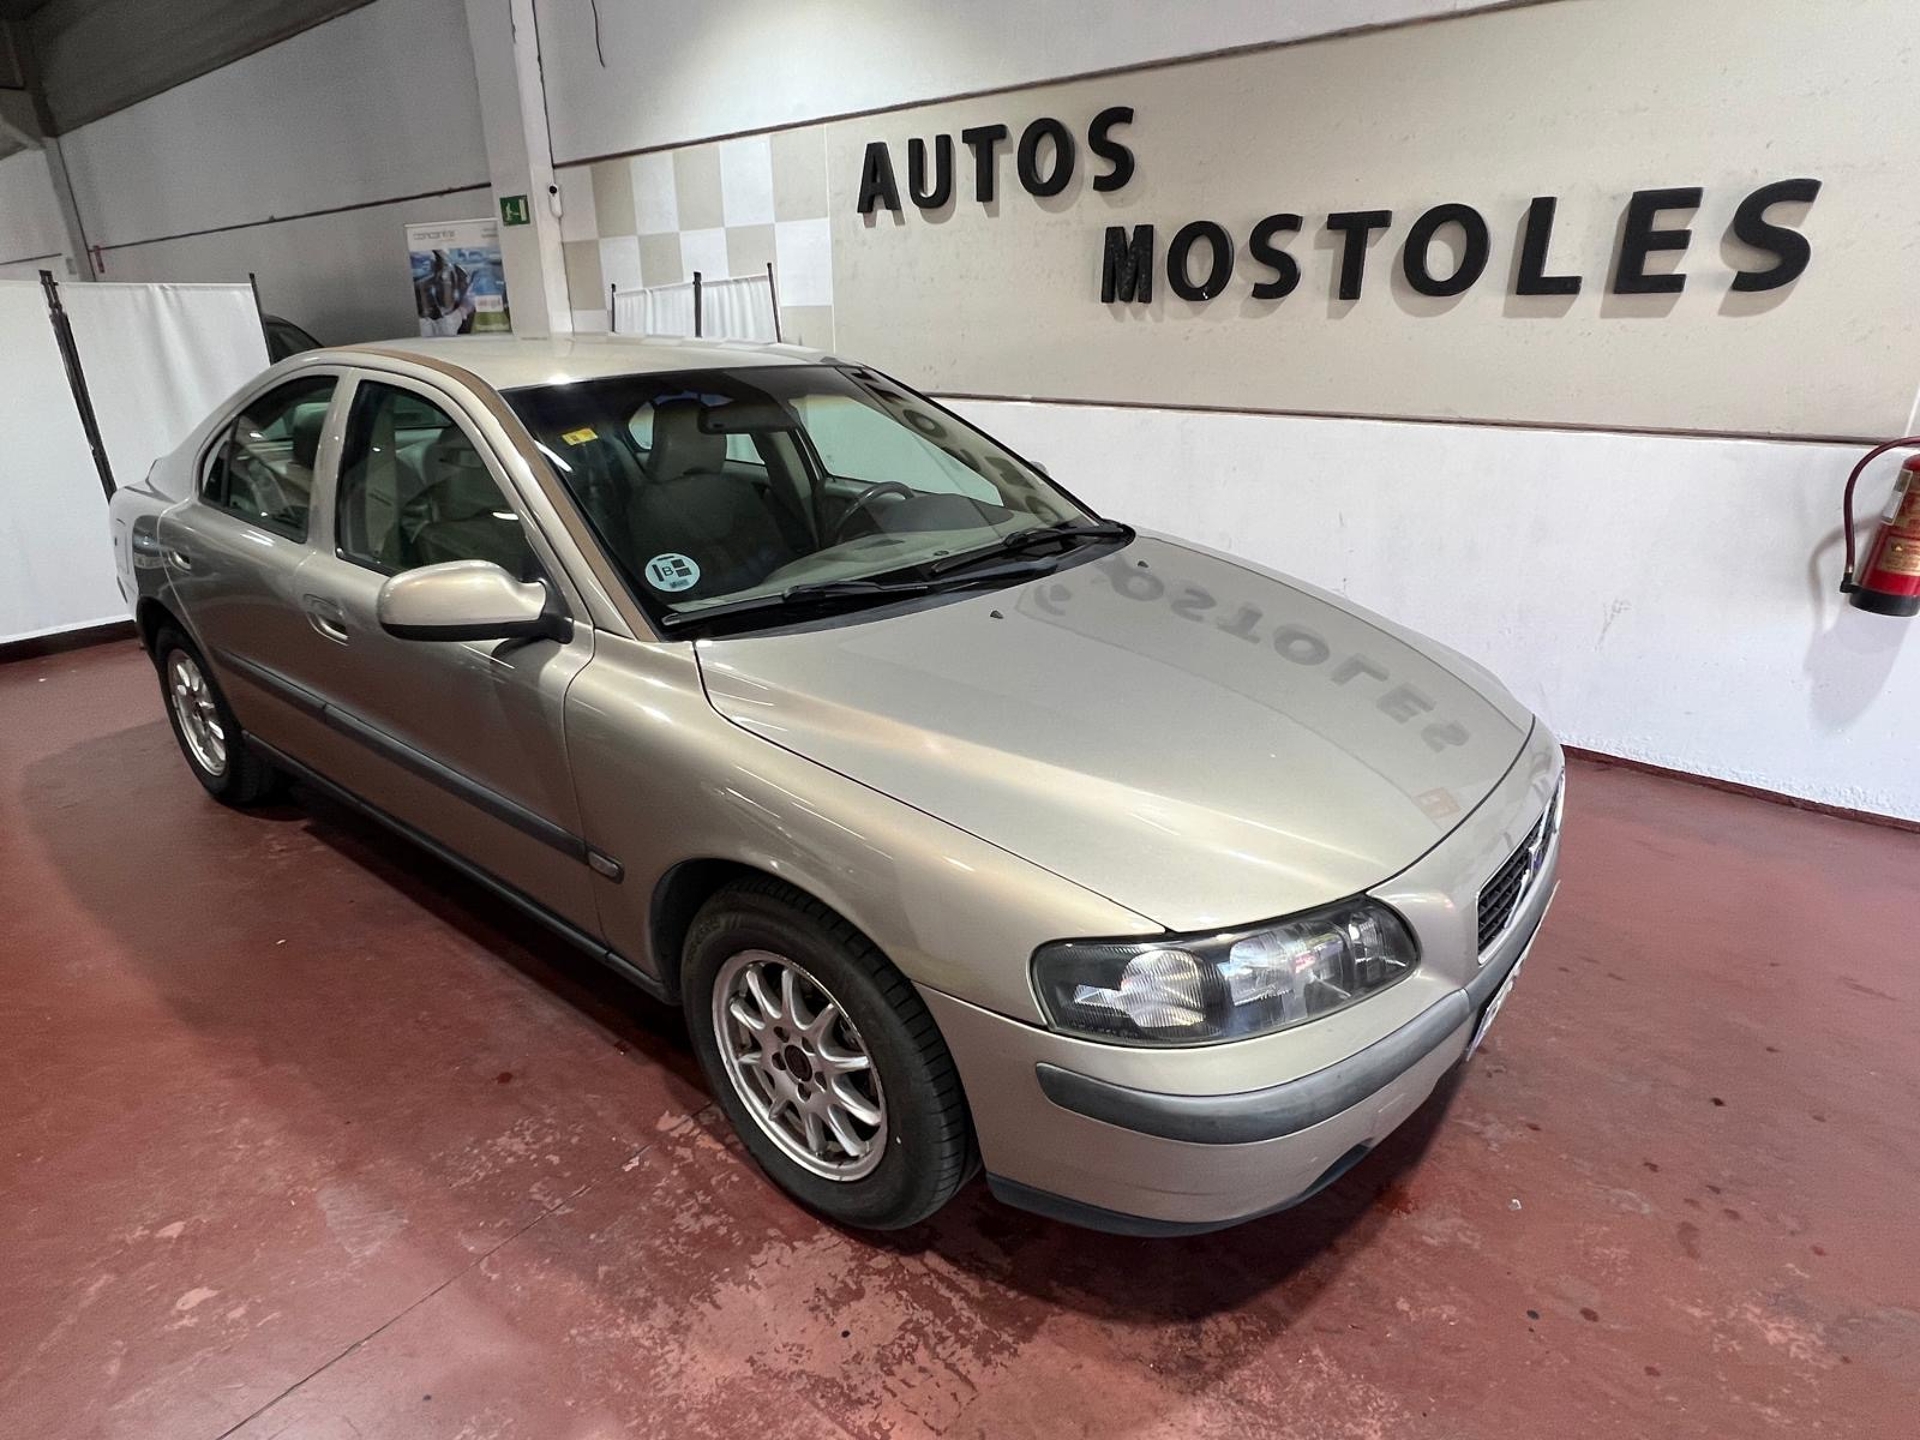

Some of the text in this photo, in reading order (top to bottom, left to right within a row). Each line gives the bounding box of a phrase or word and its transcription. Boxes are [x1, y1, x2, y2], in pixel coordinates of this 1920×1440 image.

[857, 106, 1135, 215] AUTOS
[1100, 178, 1821, 304] MOSTOLES
[662, 566, 674, 577] B
